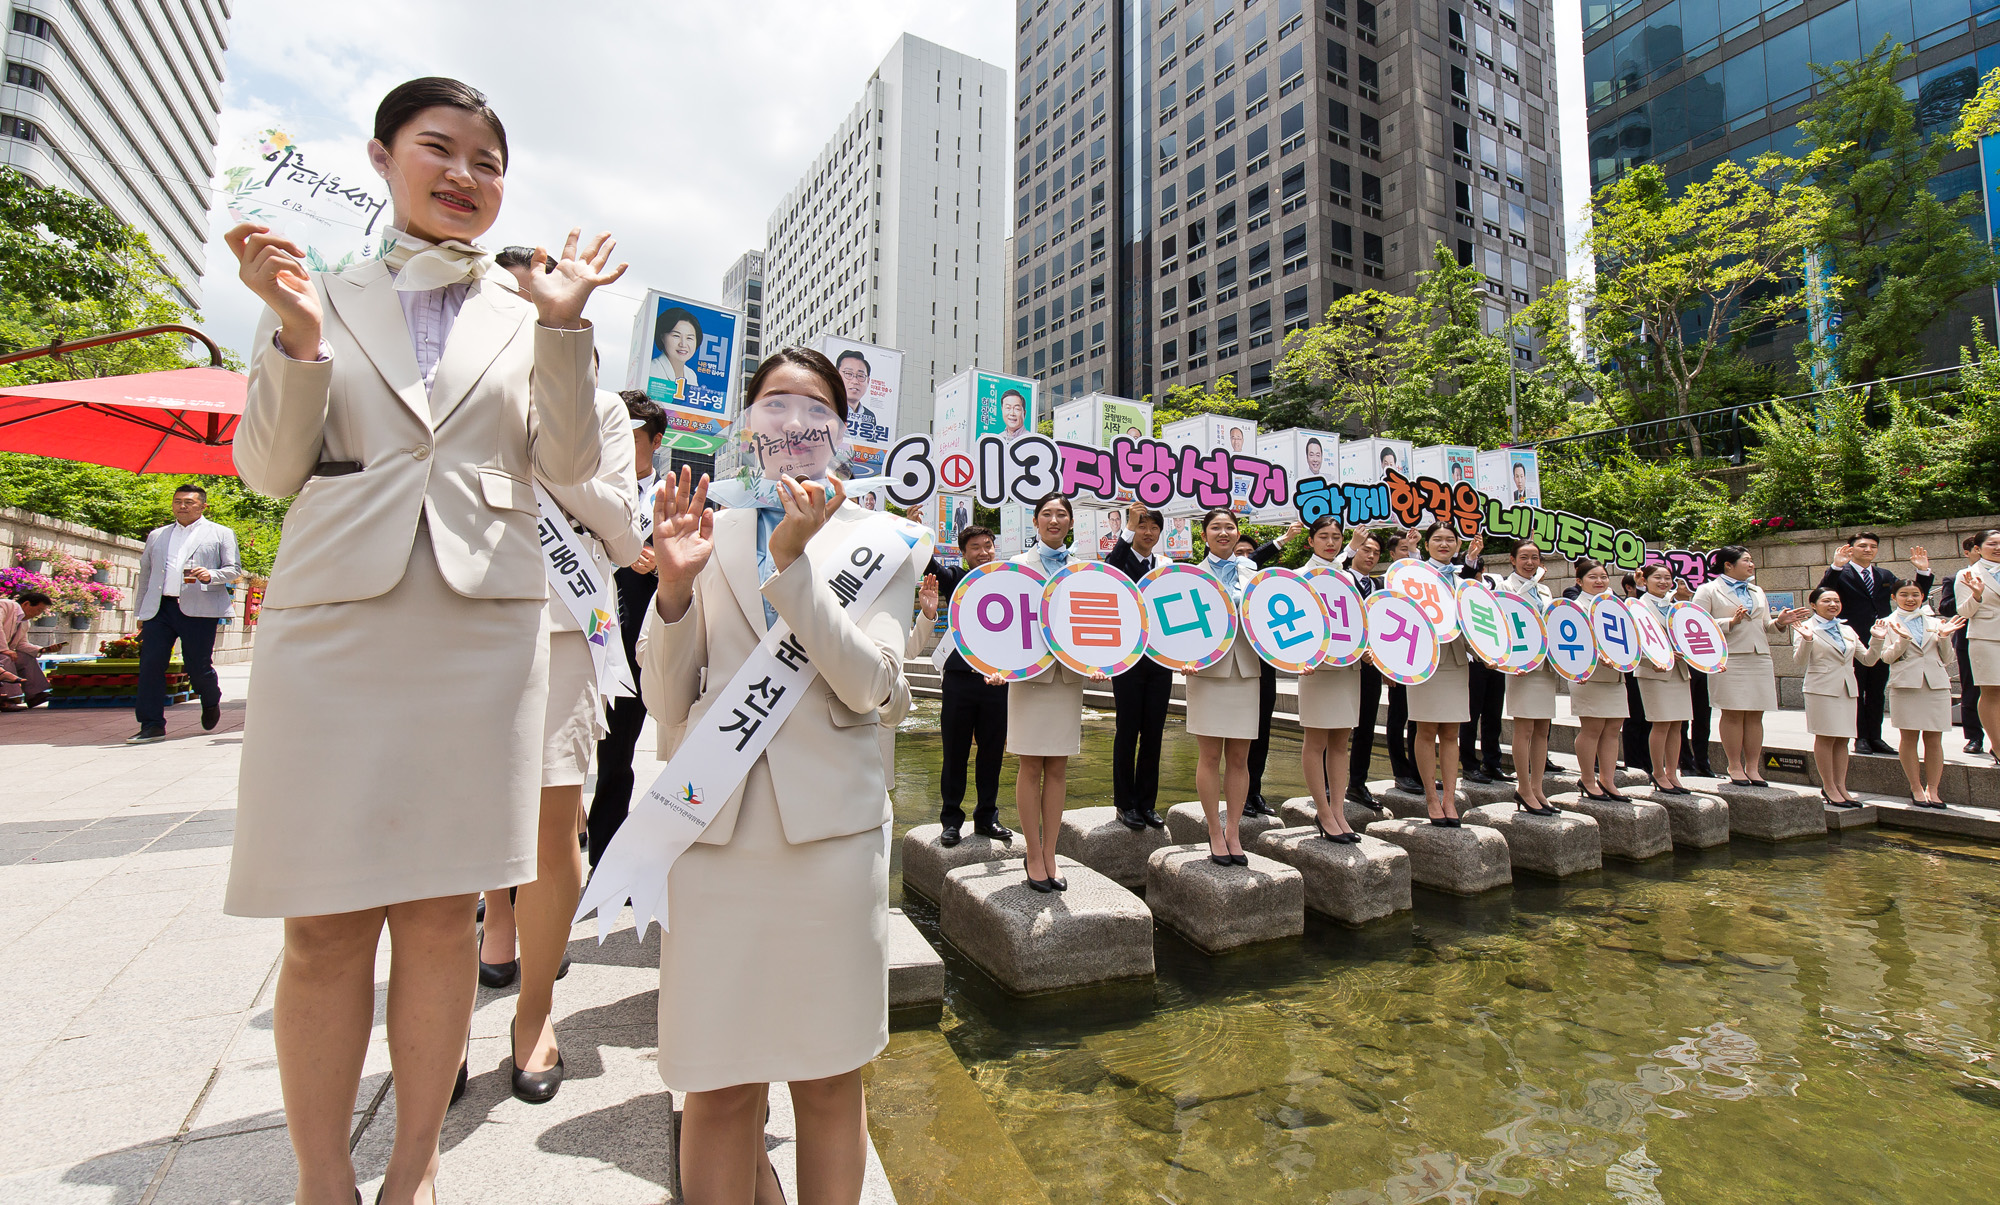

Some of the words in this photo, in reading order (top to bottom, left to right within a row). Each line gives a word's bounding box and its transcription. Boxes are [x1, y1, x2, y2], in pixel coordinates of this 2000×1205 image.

[699, 333, 729, 371] 더
[673, 377, 686, 401] 1
[688, 390, 724, 410] 김수영
[1104, 403, 1117, 413] 양천
[667, 416, 690, 428] 구청장
[691, 421, 713, 432] 후보자
[846, 420, 889, 442] 강웅원
[1103, 422, 1121, 434] 시작
[1104, 412, 1133, 424] 균형발전의
[1294, 476, 1391, 530] 함께
[1480, 491, 1533, 539] 네
[537, 503, 598, 598] 리동네
[1168, 537, 1175, 547] 3
[775, 546, 885, 673] 아름운
[718, 675, 788, 752] 선거
[649, 790, 707, 828] 서울특별시선거관리위원회
